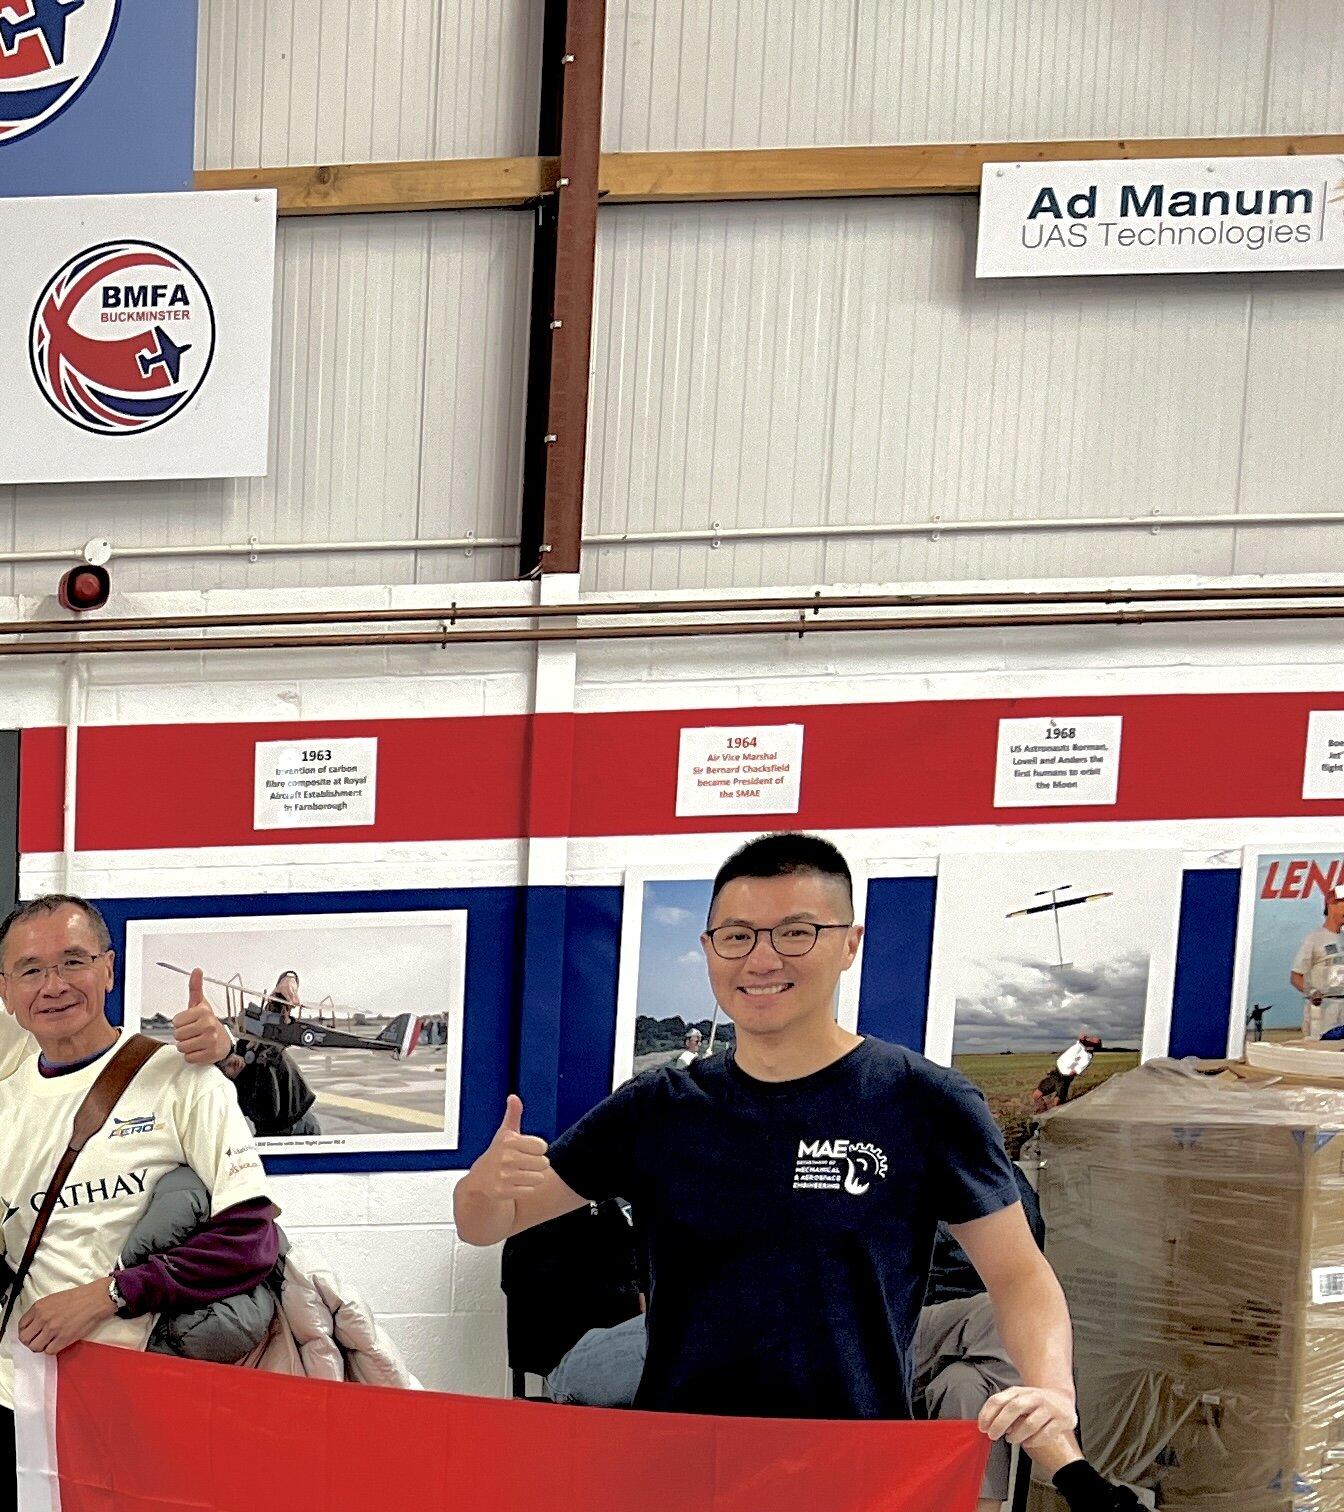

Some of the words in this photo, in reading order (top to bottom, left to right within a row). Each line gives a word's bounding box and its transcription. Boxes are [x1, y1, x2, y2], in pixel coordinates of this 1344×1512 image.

[1027, 186, 1098, 219] Ad
[1120, 185, 1314, 217] Manum
[1022, 224, 1088, 248] UAS
[1098, 219, 1312, 250] Technologies
[101, 284, 190, 309] BMFA
[100, 310, 191, 323] BUCKMINSTER
[726, 737, 757, 749] 1964
[1045, 728, 1076, 740] 1968
[301, 750, 332, 762] 1963
[1261, 858, 1344, 900] LEN
[798, 1140, 850, 1158] MAE
